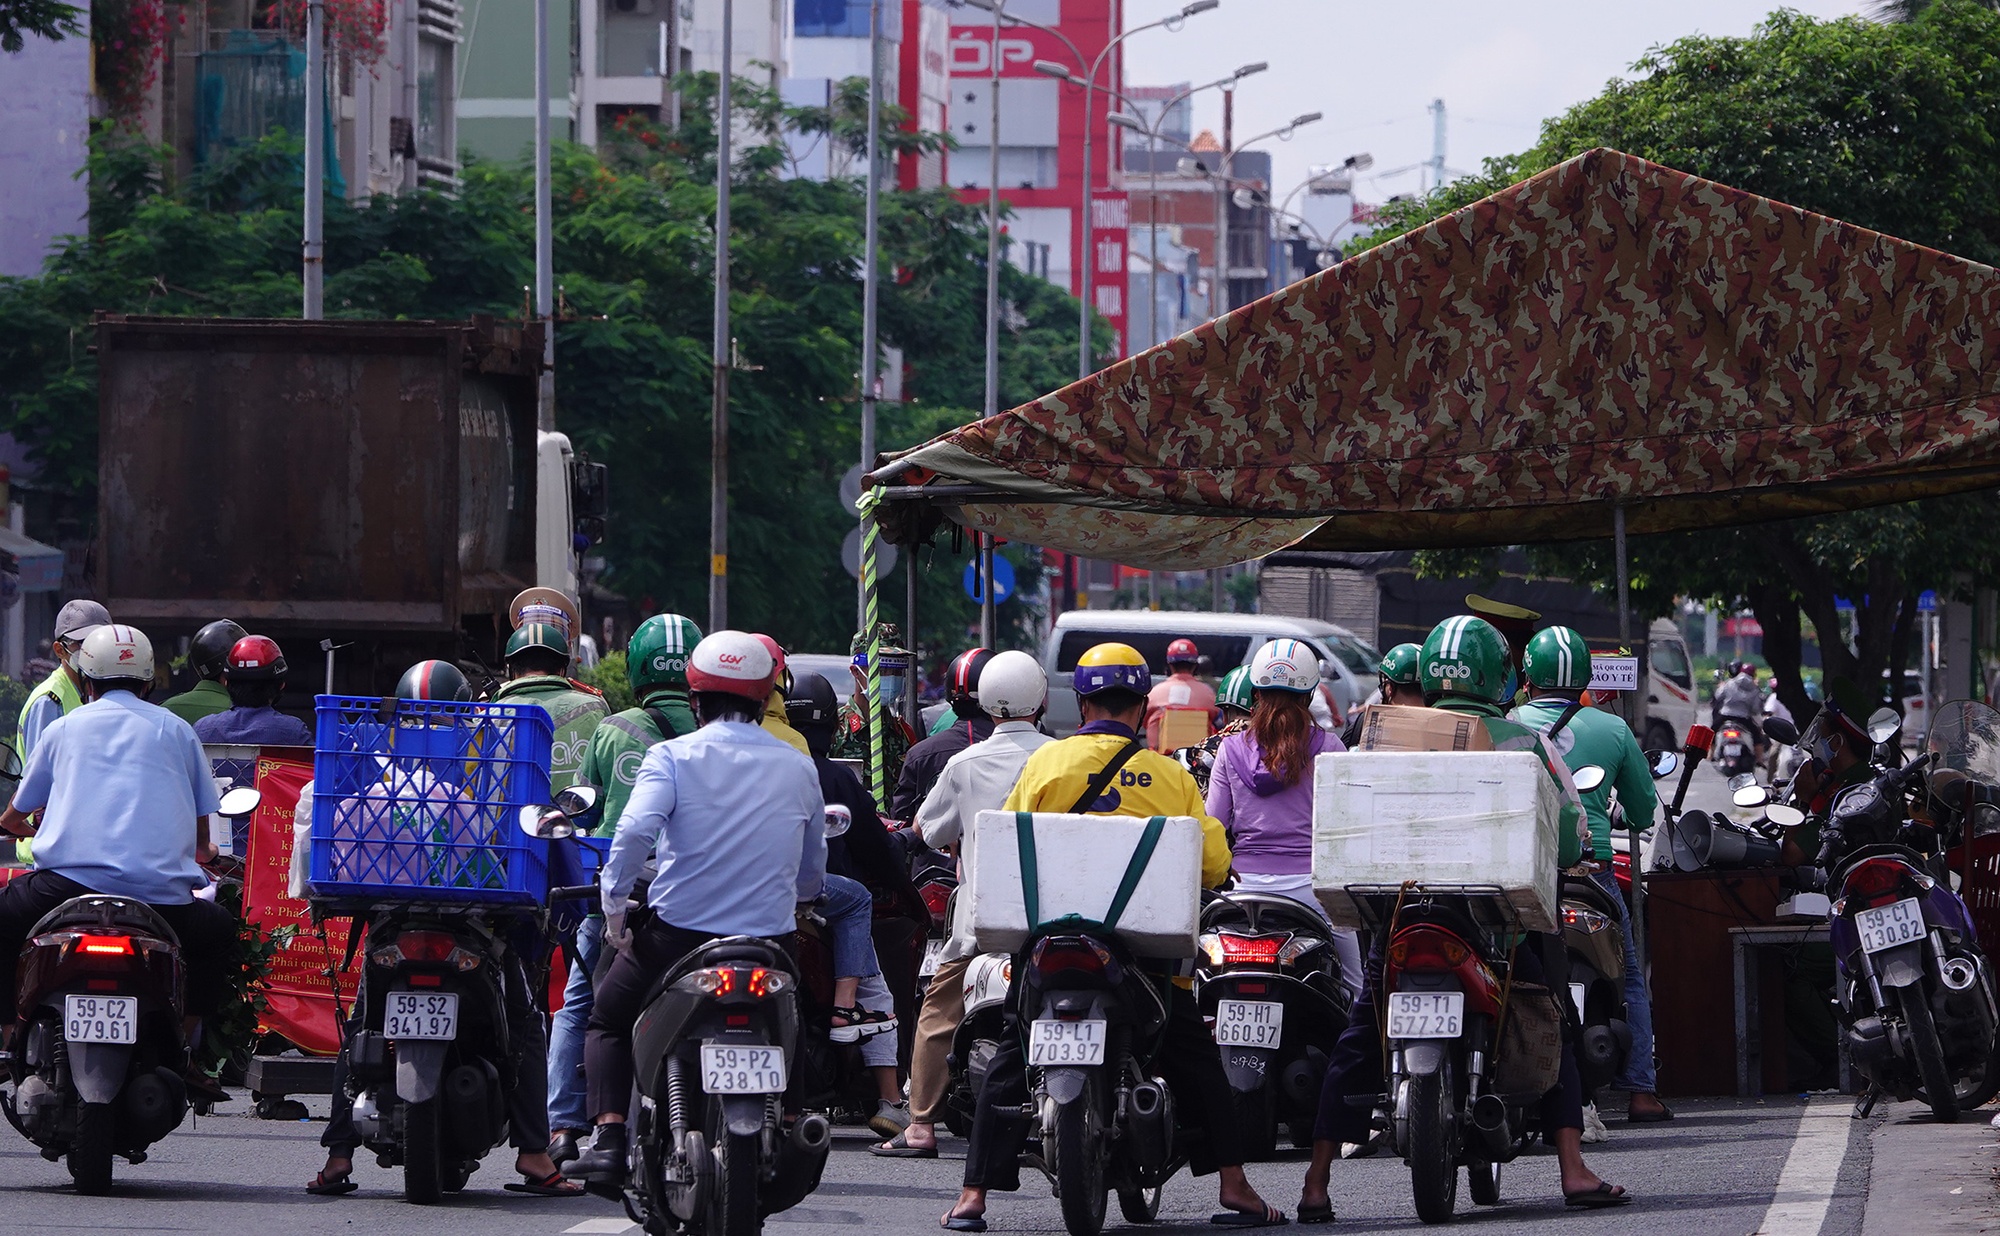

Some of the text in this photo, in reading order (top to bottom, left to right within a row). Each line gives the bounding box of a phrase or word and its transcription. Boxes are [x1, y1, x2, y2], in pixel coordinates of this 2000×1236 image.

[719, 653, 743, 664] CGV
[1428, 661, 1471, 679] Grab
[1611, 674, 1618, 682] Y
[1121, 769, 1152, 787] be
[273, 823, 281, 833] 1.
[269, 856, 278, 866] 2.
[265, 906, 274, 916] 3.
[1865, 904, 1909, 930] 59-C1
[1864, 920, 1921, 951] 130.82
[327, 945, 346, 955] cho
[77, 999, 126, 1019] 59-C2
[397, 996, 447, 1015] 59-S2
[1401, 995, 1450, 1013] 59-T1
[1227, 1004, 1271, 1024] 59-H1
[70, 1020, 130, 1041] 979.61
[389, 1016, 451, 1036] 341.97
[1043, 1024, 1093, 1041] 59-L1
[1220, 1022, 1277, 1044] 660.97
[1393, 1015, 1457, 1035] 577.26
[715, 1049, 772, 1069] 59-P2
[1034, 1043, 1099, 1061] 703.97
[709, 1070, 780, 1089] 238.10
